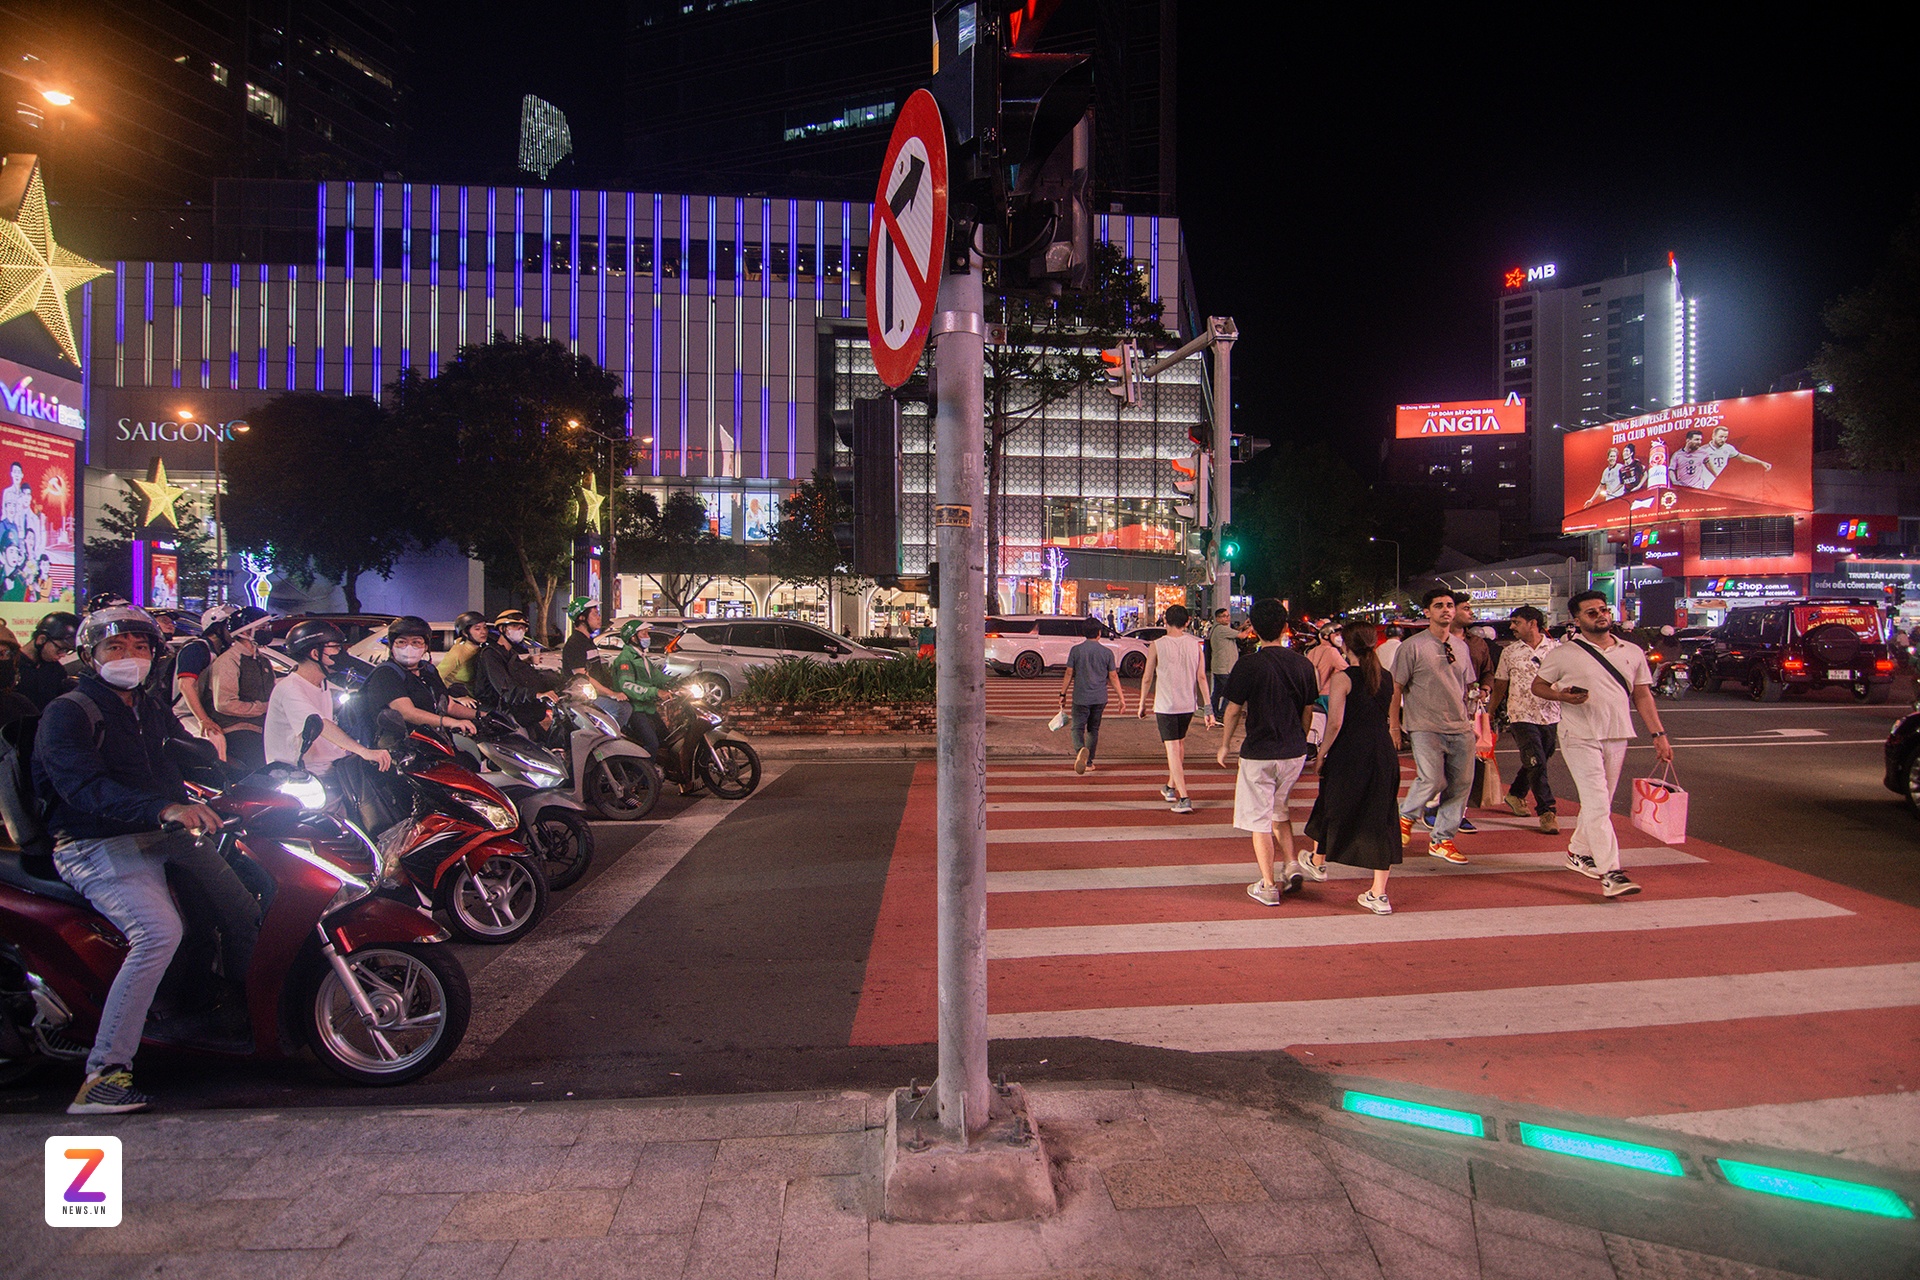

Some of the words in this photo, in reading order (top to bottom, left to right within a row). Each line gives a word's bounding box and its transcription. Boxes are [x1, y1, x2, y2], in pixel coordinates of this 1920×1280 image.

[1528, 264, 1556, 282] MB
[0, 376, 58, 423] Vikki
[1671, 406, 1696, 419] NHẬP
[1697, 403, 1719, 416] TIỆC
[116, 418, 224, 442] SAIGON
[1612, 432, 1626, 444] FIFA
[1627, 428, 1646, 441] CLUB
[1646, 422, 1674, 437] WORLD
[1674, 418, 1692, 431] CUP
[1871, 571, 1884, 579] TÂM
[1736, 582, 1790, 591] Shop.com.vn
[1847, 581, 1865, 589] CÔNG
[1472, 590, 1497, 600] SQUARE
